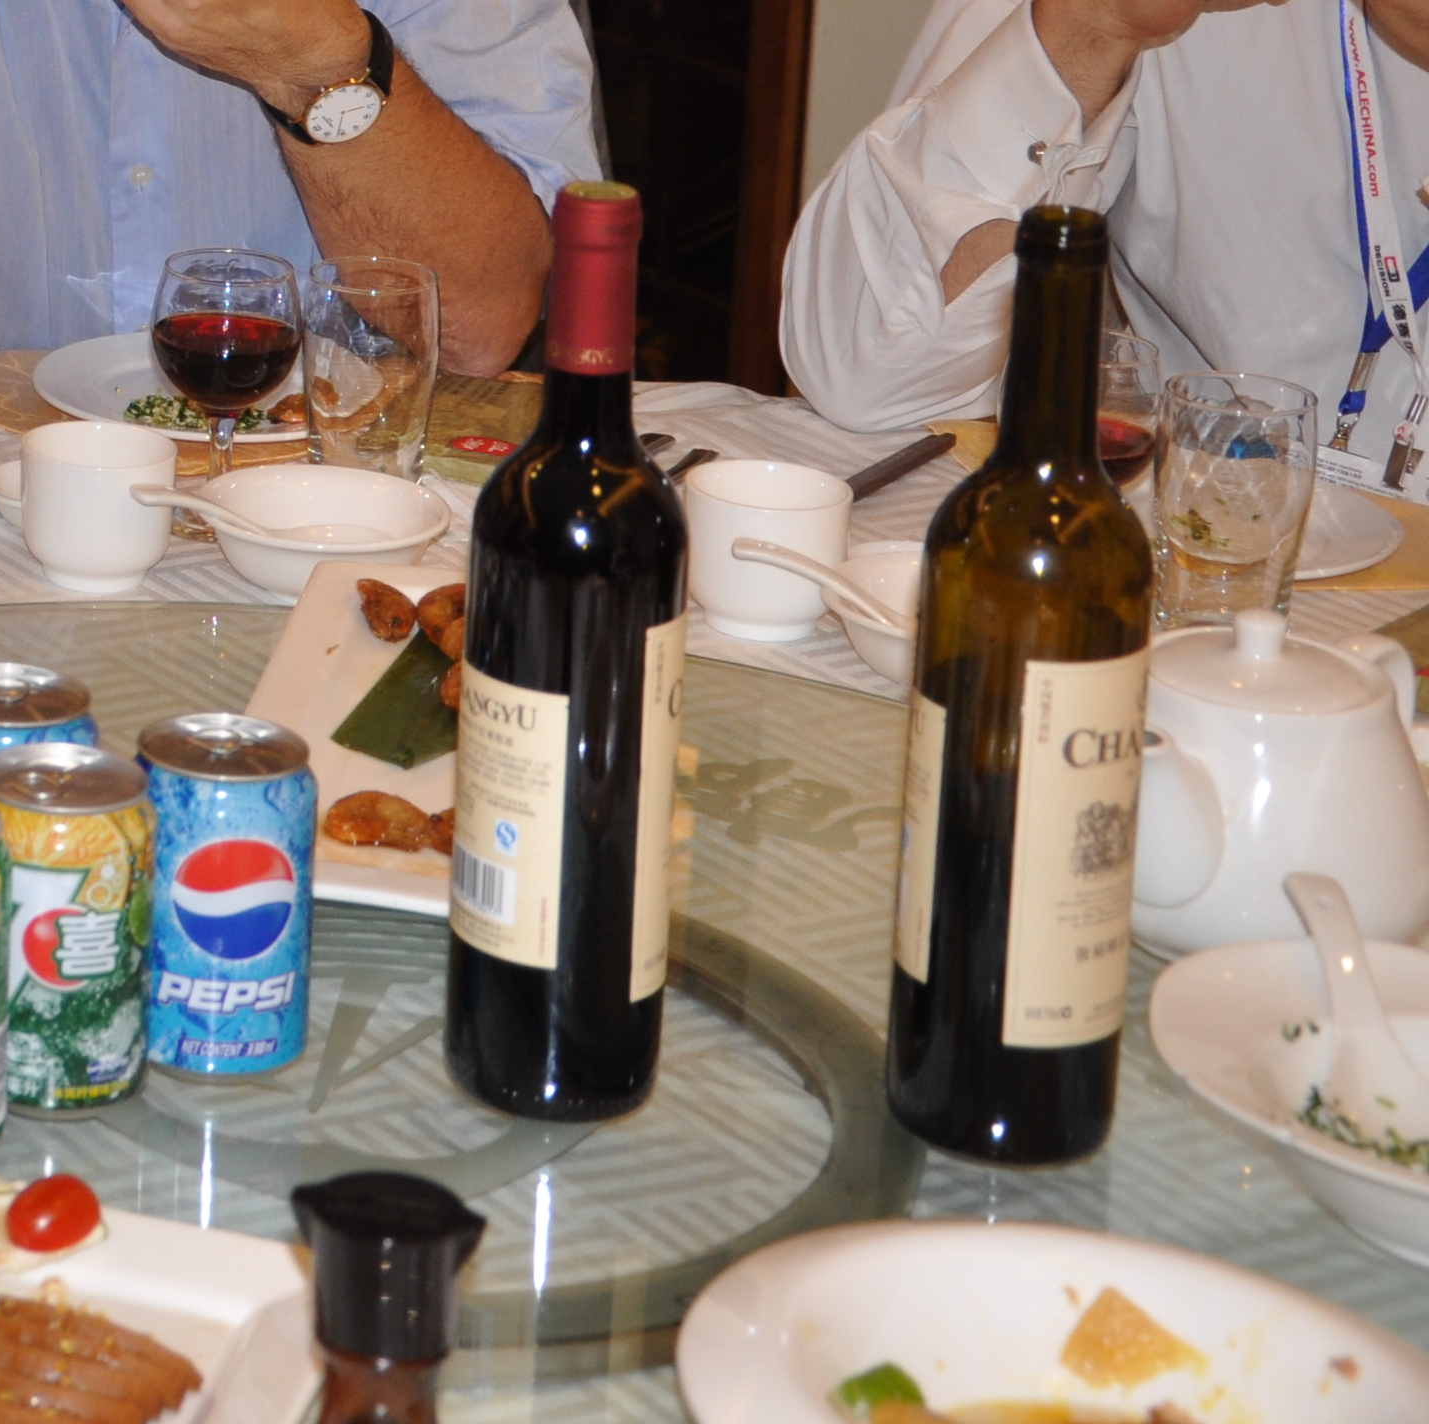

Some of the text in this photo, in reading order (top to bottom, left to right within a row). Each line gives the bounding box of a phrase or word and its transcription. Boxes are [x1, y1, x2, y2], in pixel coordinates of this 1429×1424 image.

[1348, 16, 1379, 198] www.ACLECHINA.com
[462, 686, 538, 731] ANGYU
[55, 910, 121, 976] 喜
[157, 970, 296, 1014] PEPSI
